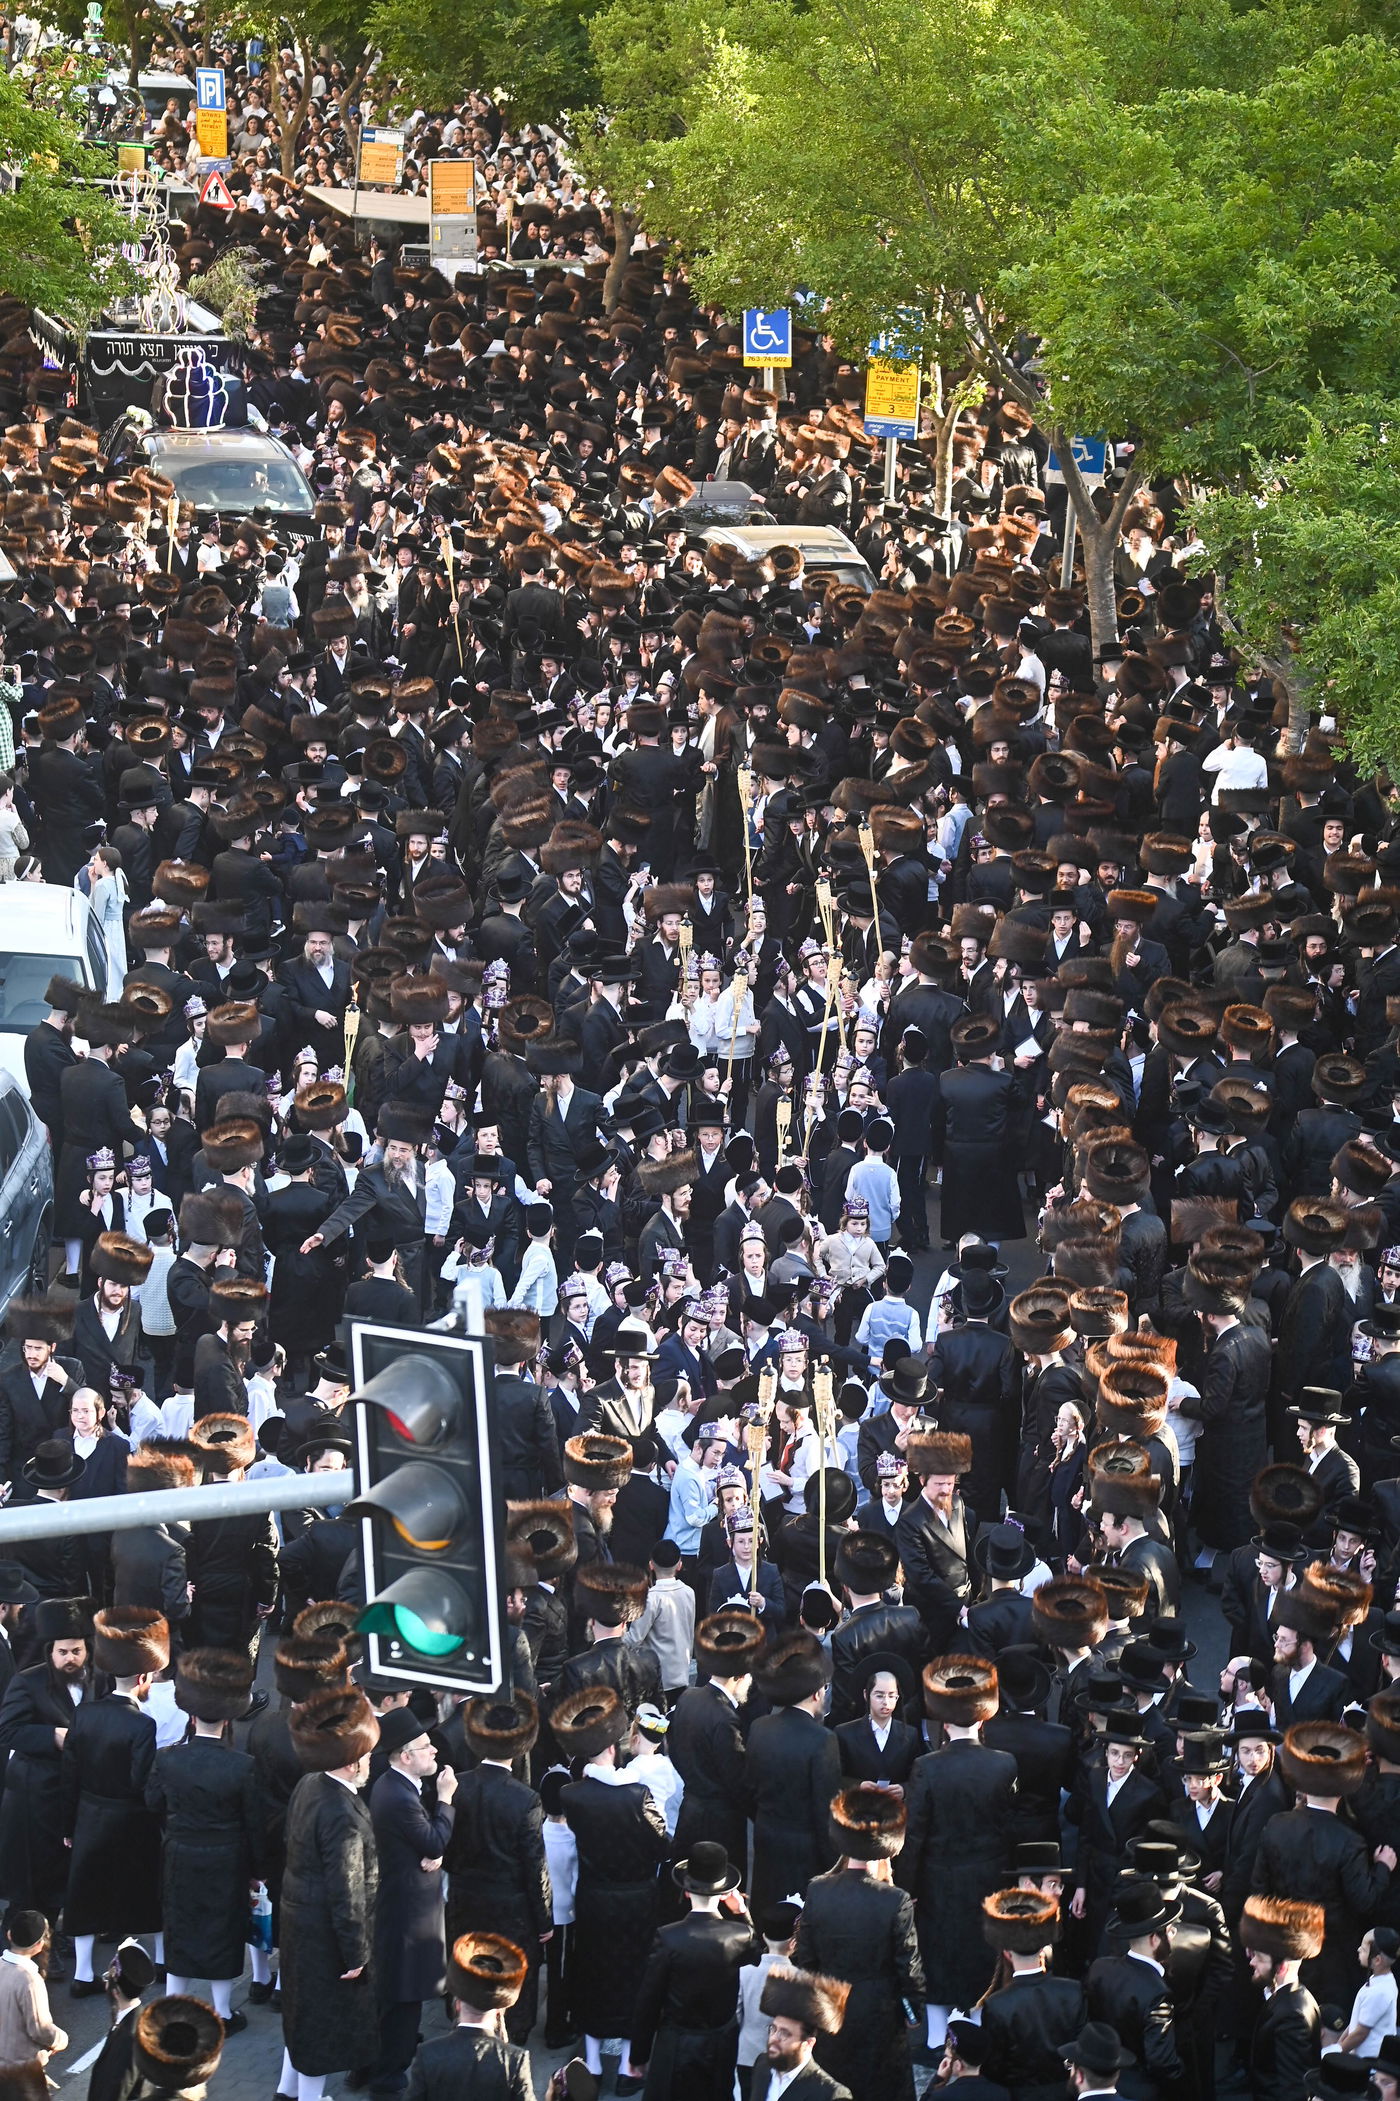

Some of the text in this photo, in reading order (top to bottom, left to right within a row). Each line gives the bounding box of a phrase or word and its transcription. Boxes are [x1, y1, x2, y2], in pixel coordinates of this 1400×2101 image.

[106, 341, 134, 356] תורה
[139, 343, 164, 357] תצא
[208, 344, 219, 358] כי
[875, 374, 910, 383] PAYMENT
[888, 404, 895, 414] 3
